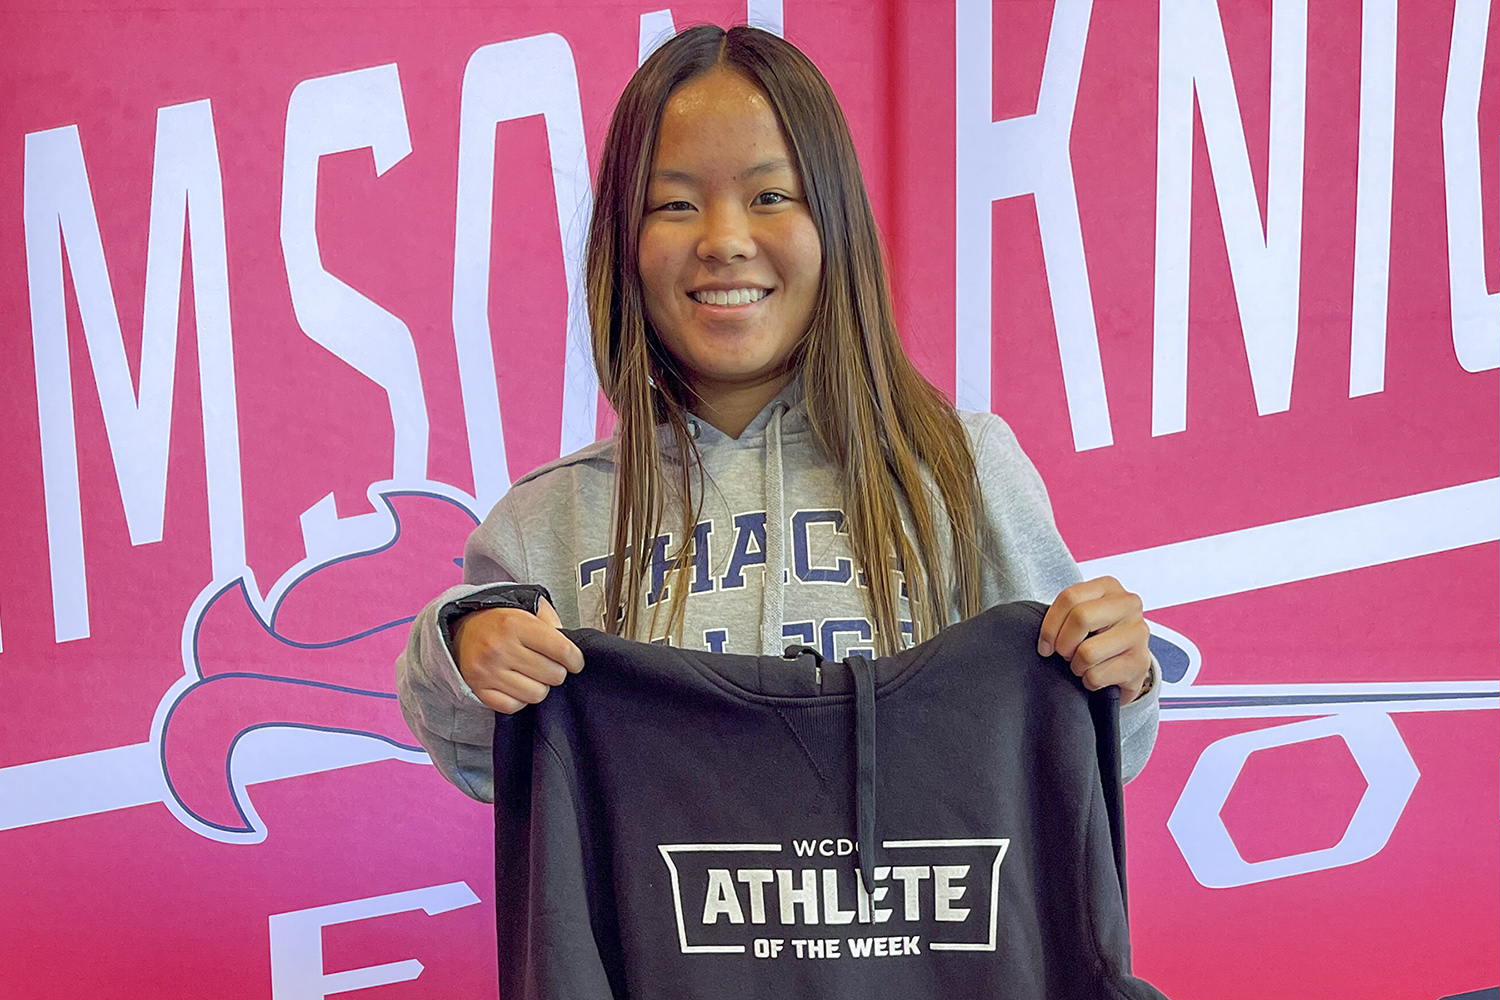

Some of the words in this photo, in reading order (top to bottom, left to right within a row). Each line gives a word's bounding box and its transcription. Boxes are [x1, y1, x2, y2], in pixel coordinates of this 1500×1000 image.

[24, 0, 785, 643] MSO
[793, 839, 860, 857] WCD
[702, 864, 971, 925] ATHLETE
[754, 938, 784, 958] OF
[791, 938, 842, 958] THE
[847, 935, 921, 958] WEEK
